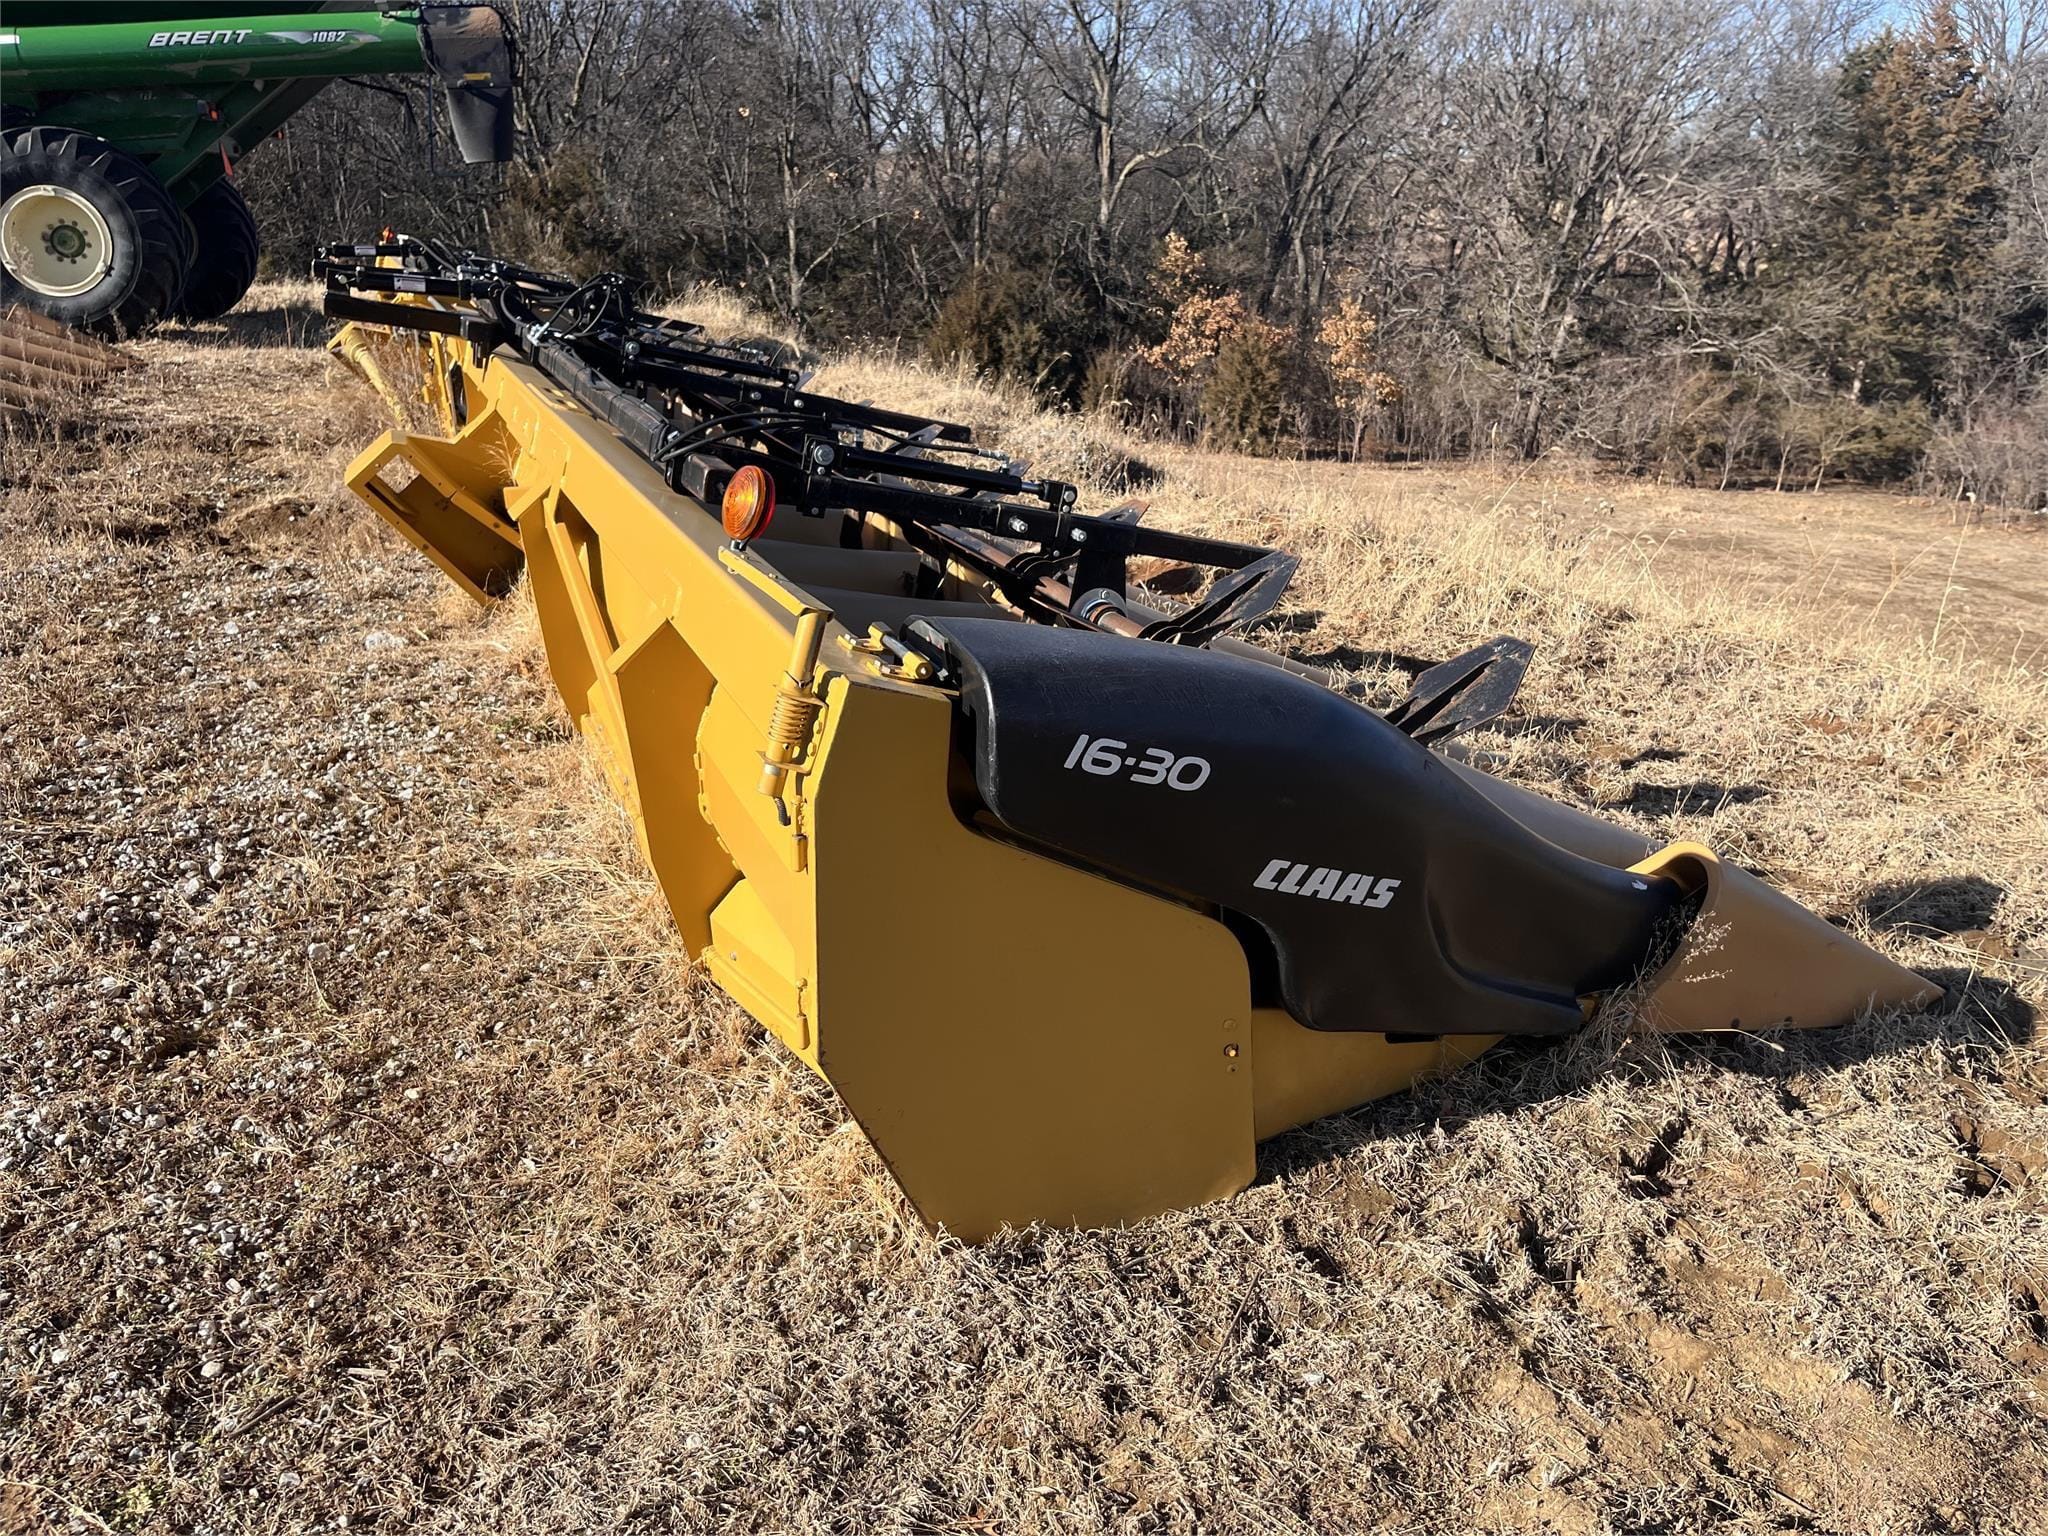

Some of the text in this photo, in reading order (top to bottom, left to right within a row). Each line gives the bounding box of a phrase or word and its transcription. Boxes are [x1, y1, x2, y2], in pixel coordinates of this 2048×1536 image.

[148, 29, 346, 47] BRENT 1082
[1253, 859, 1402, 909] CLAAS
